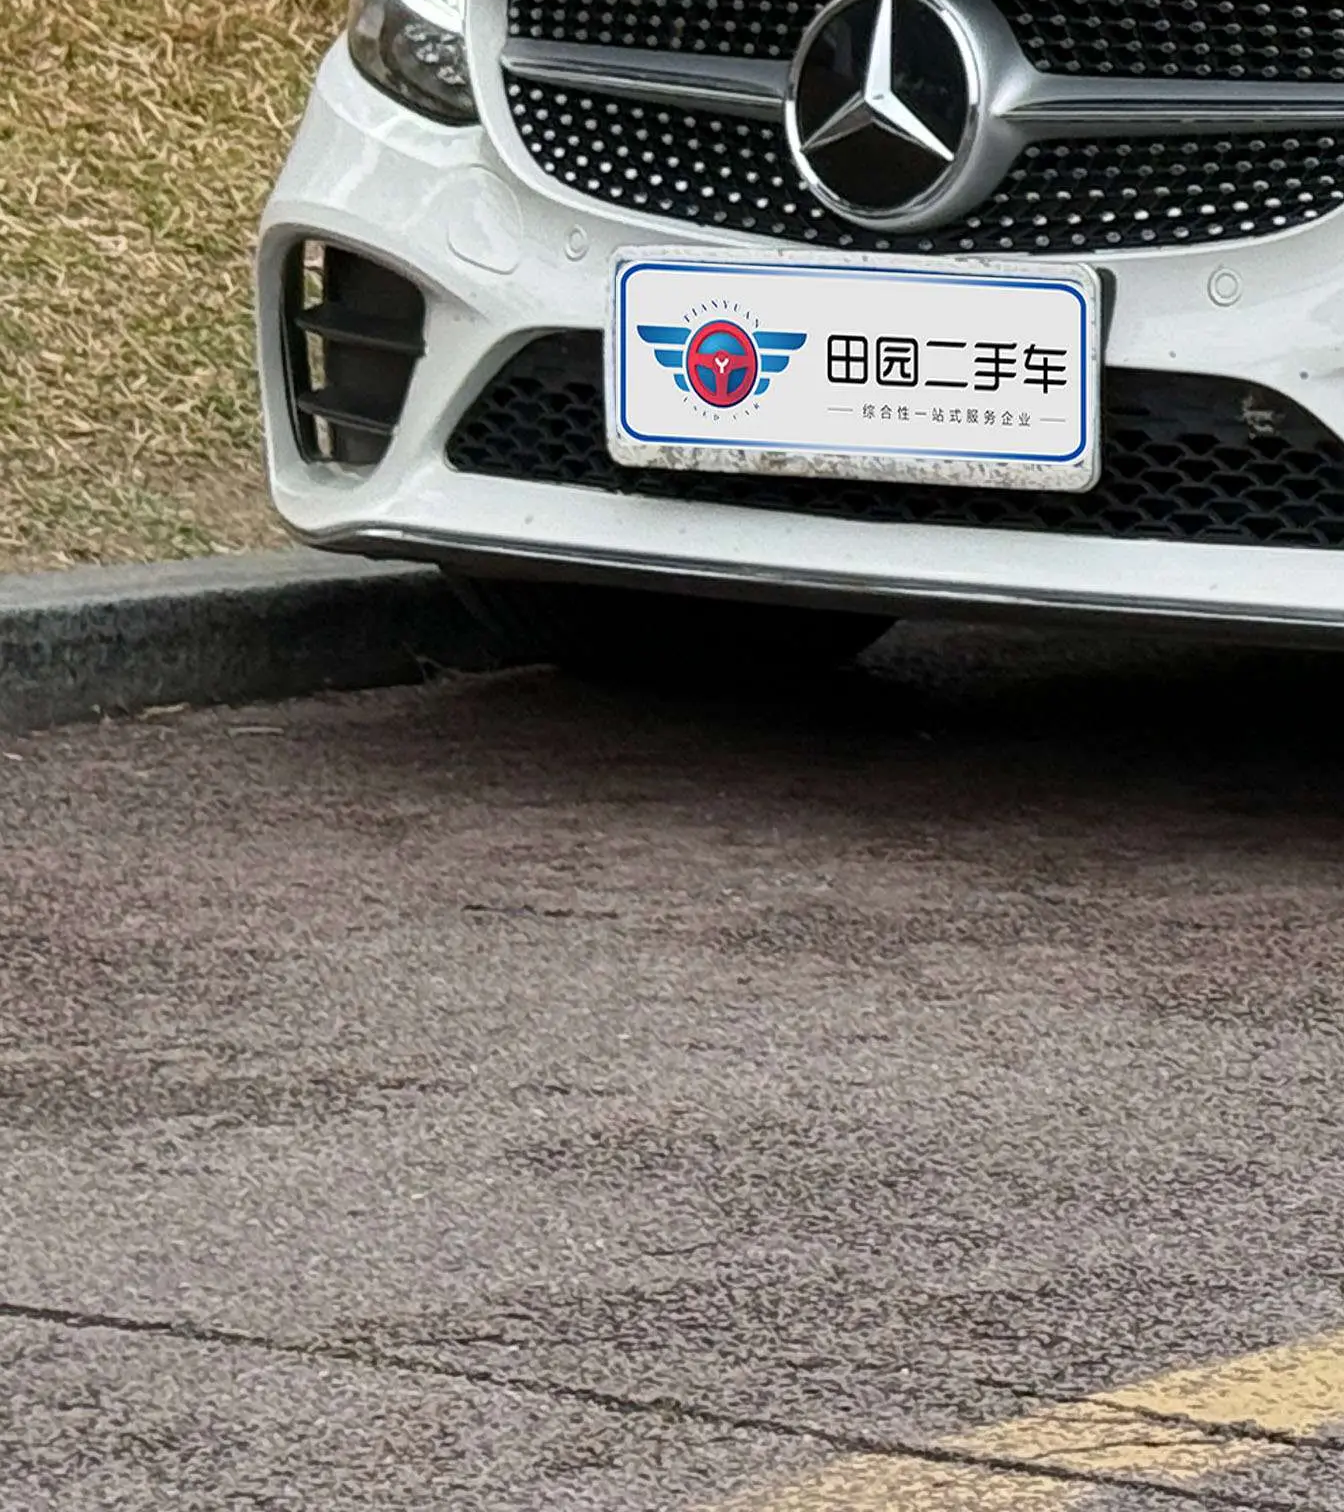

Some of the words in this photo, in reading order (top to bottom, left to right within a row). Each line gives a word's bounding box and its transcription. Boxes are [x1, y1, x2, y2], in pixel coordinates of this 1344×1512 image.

[826, 334, 1068, 395] 田园二手车
[861, 402, 1032, 428] 综合性一站式服务企业
